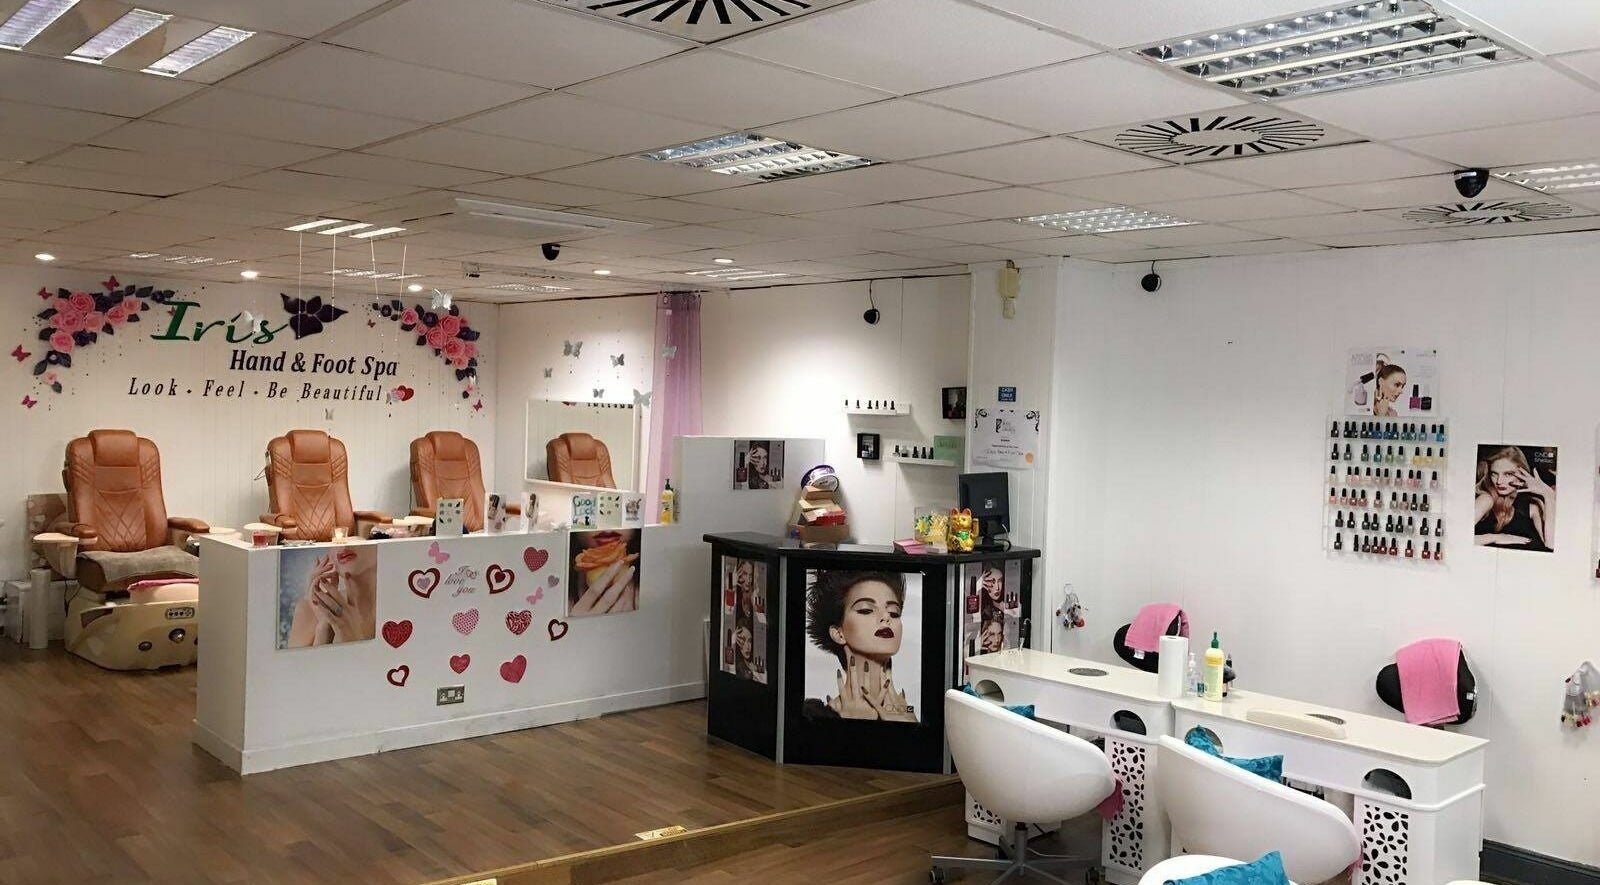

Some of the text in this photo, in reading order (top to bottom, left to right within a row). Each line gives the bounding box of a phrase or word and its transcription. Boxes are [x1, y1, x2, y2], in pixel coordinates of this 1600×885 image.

[150, 300, 289, 345] Iris
[230, 349, 398, 381] Hand & Foot Spa
[128, 377, 382, 401] Look Feel Be Beautiful
[572, 495, 597, 507] Good
[444, 573, 465, 585] love
[451, 586, 477, 598] you
